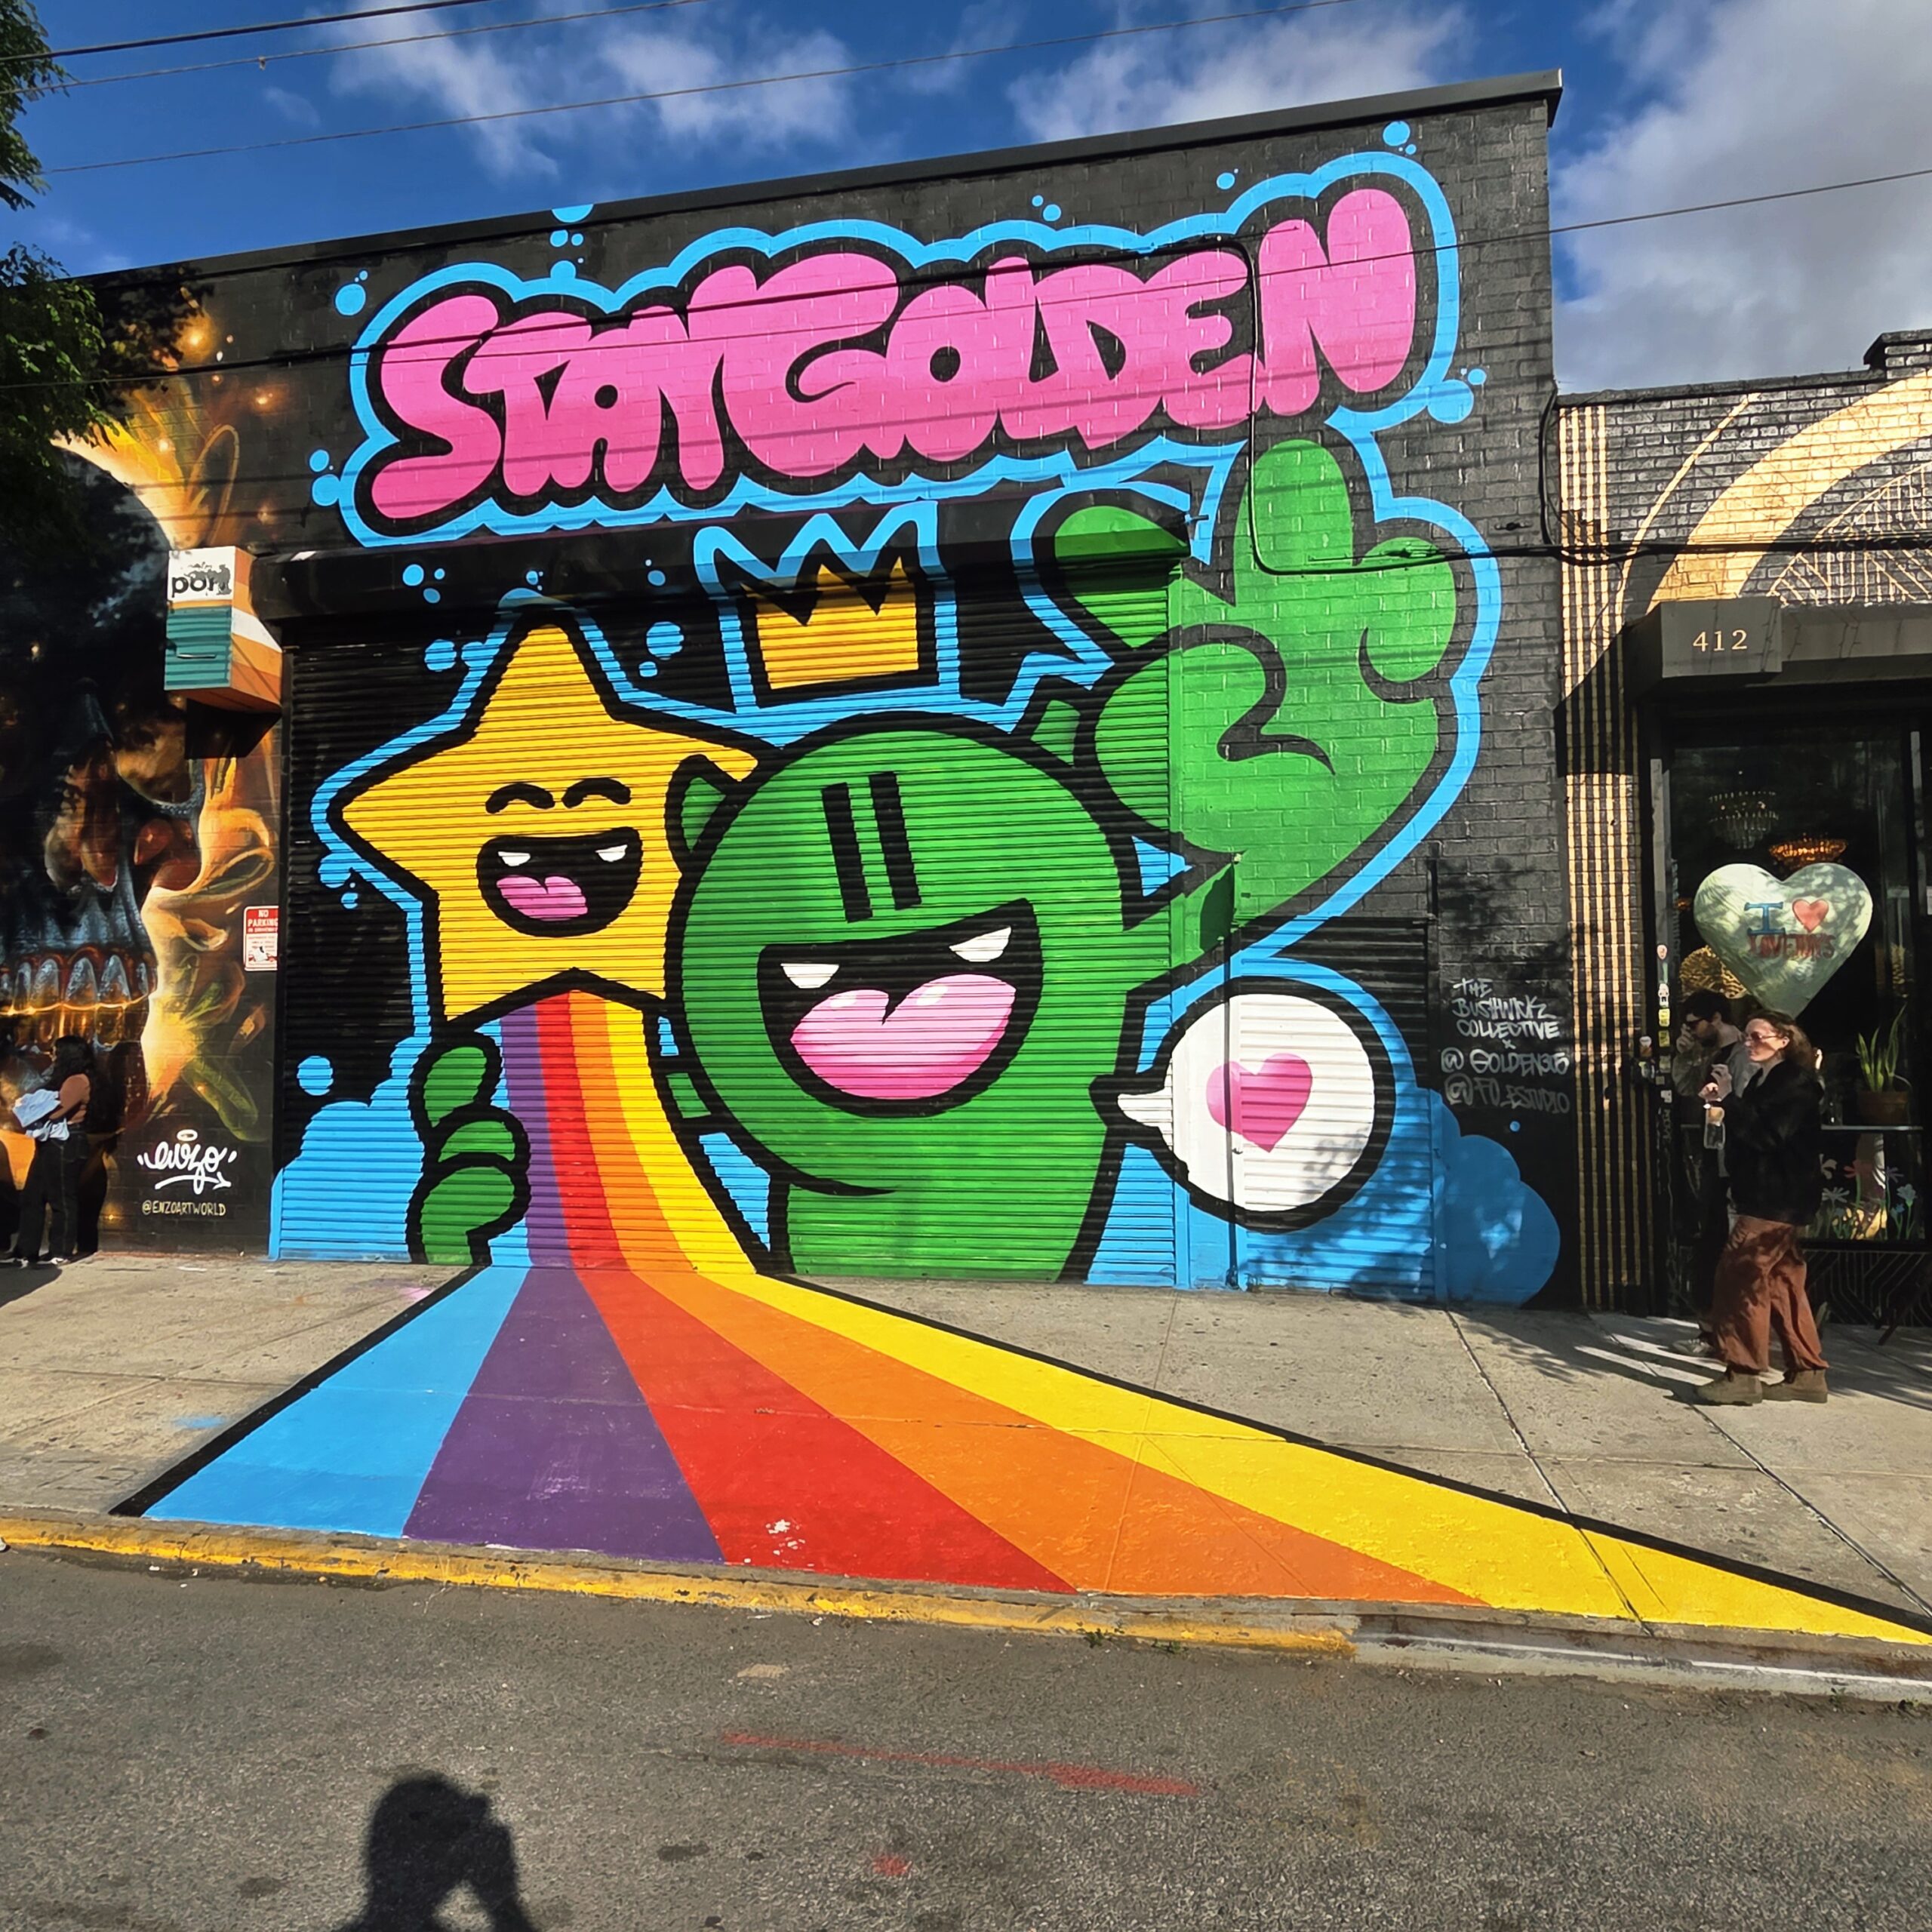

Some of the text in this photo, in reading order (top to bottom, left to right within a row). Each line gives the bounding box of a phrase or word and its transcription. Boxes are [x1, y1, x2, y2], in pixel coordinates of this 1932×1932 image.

[1692, 629, 1748, 652] 412
[258, 909, 269, 918] NO
[1453, 977, 1494, 998] THE
[1457, 1020, 1561, 1041] COLLECTIVE
[142, 1199, 226, 1217] @ENZOARTWORLD
